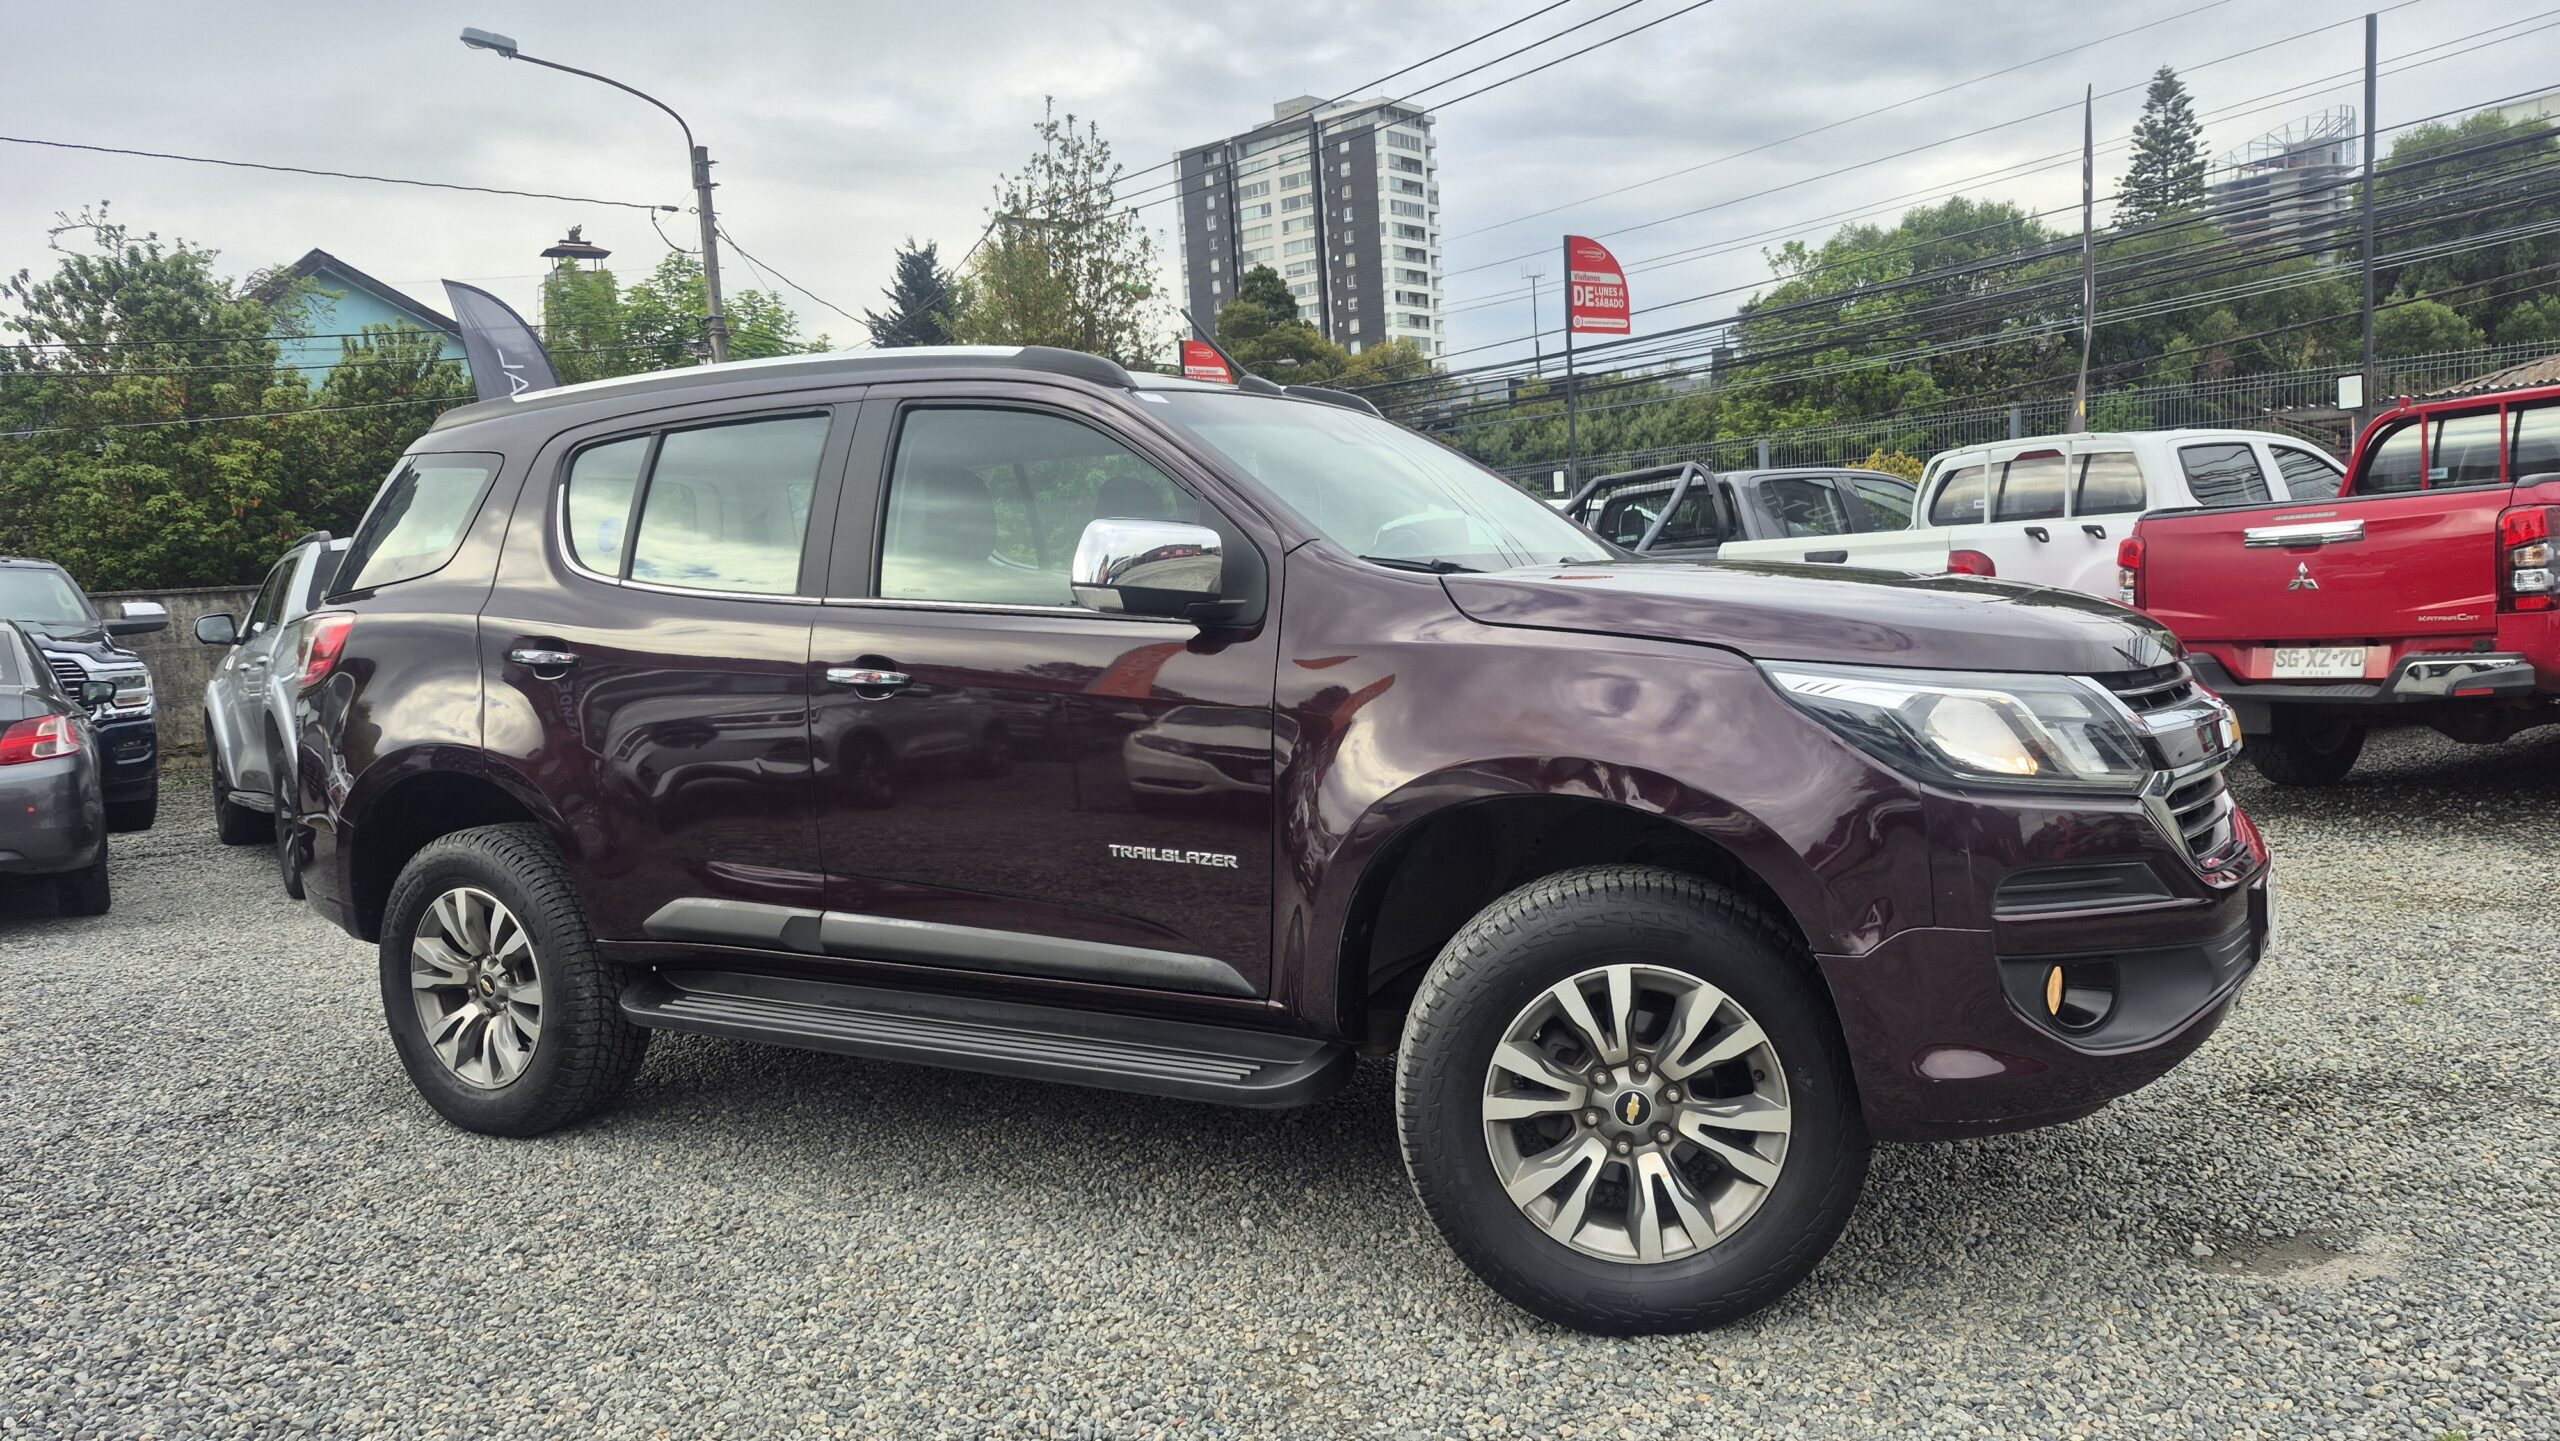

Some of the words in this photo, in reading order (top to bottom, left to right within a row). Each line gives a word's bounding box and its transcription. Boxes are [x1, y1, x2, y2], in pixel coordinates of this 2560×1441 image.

[1573, 285, 1594, 308] DE
[1594, 286, 1618, 297] LUNES
[1618, 288, 1624, 297] A
[1594, 296, 1624, 309] SÁBADO
[1108, 844, 1239, 869] TRAILBLAZER
